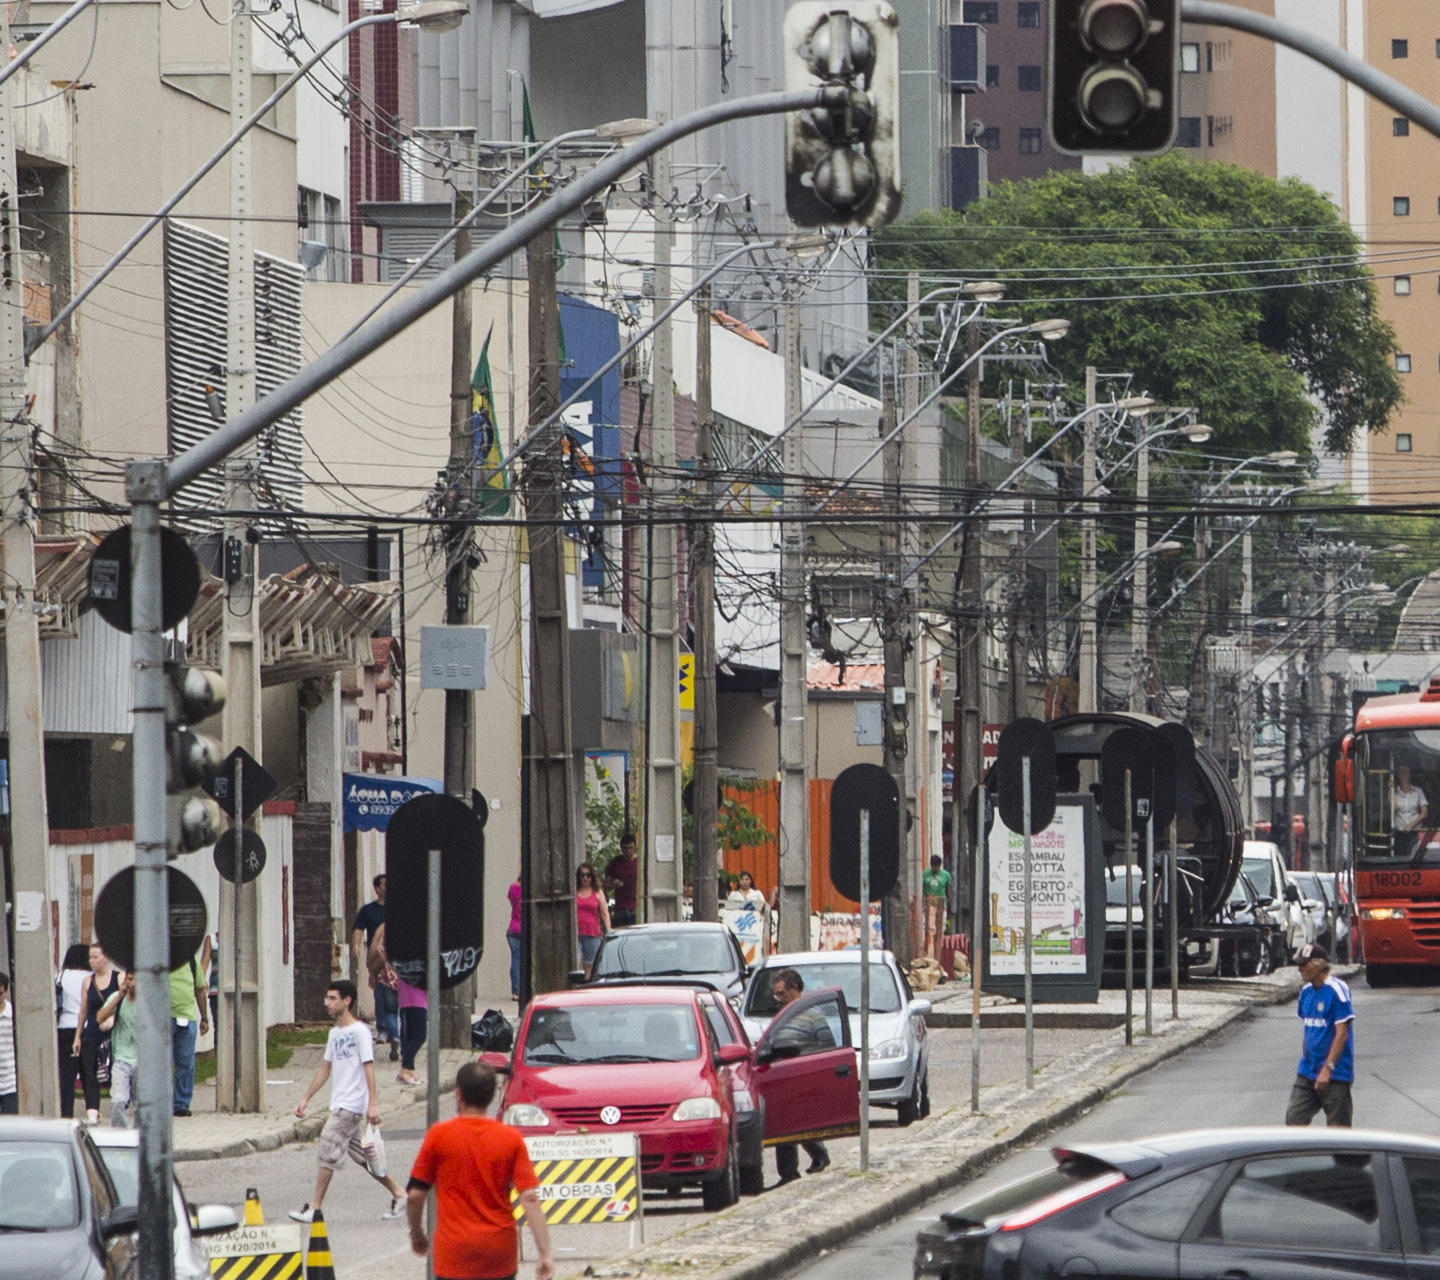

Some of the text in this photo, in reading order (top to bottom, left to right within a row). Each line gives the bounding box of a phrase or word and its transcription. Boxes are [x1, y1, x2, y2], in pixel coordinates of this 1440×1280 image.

[347, 784, 389, 804] ÁGUA
[1009, 863, 1066, 873] ED OTTA
[1009, 880, 1066, 892] EGERTO
[532, 1138, 596, 1148] AUTORIZAÇÃO
[559, 1183, 615, 1198] OBRAS
[225, 1240, 277, 1253] 1420/2014
